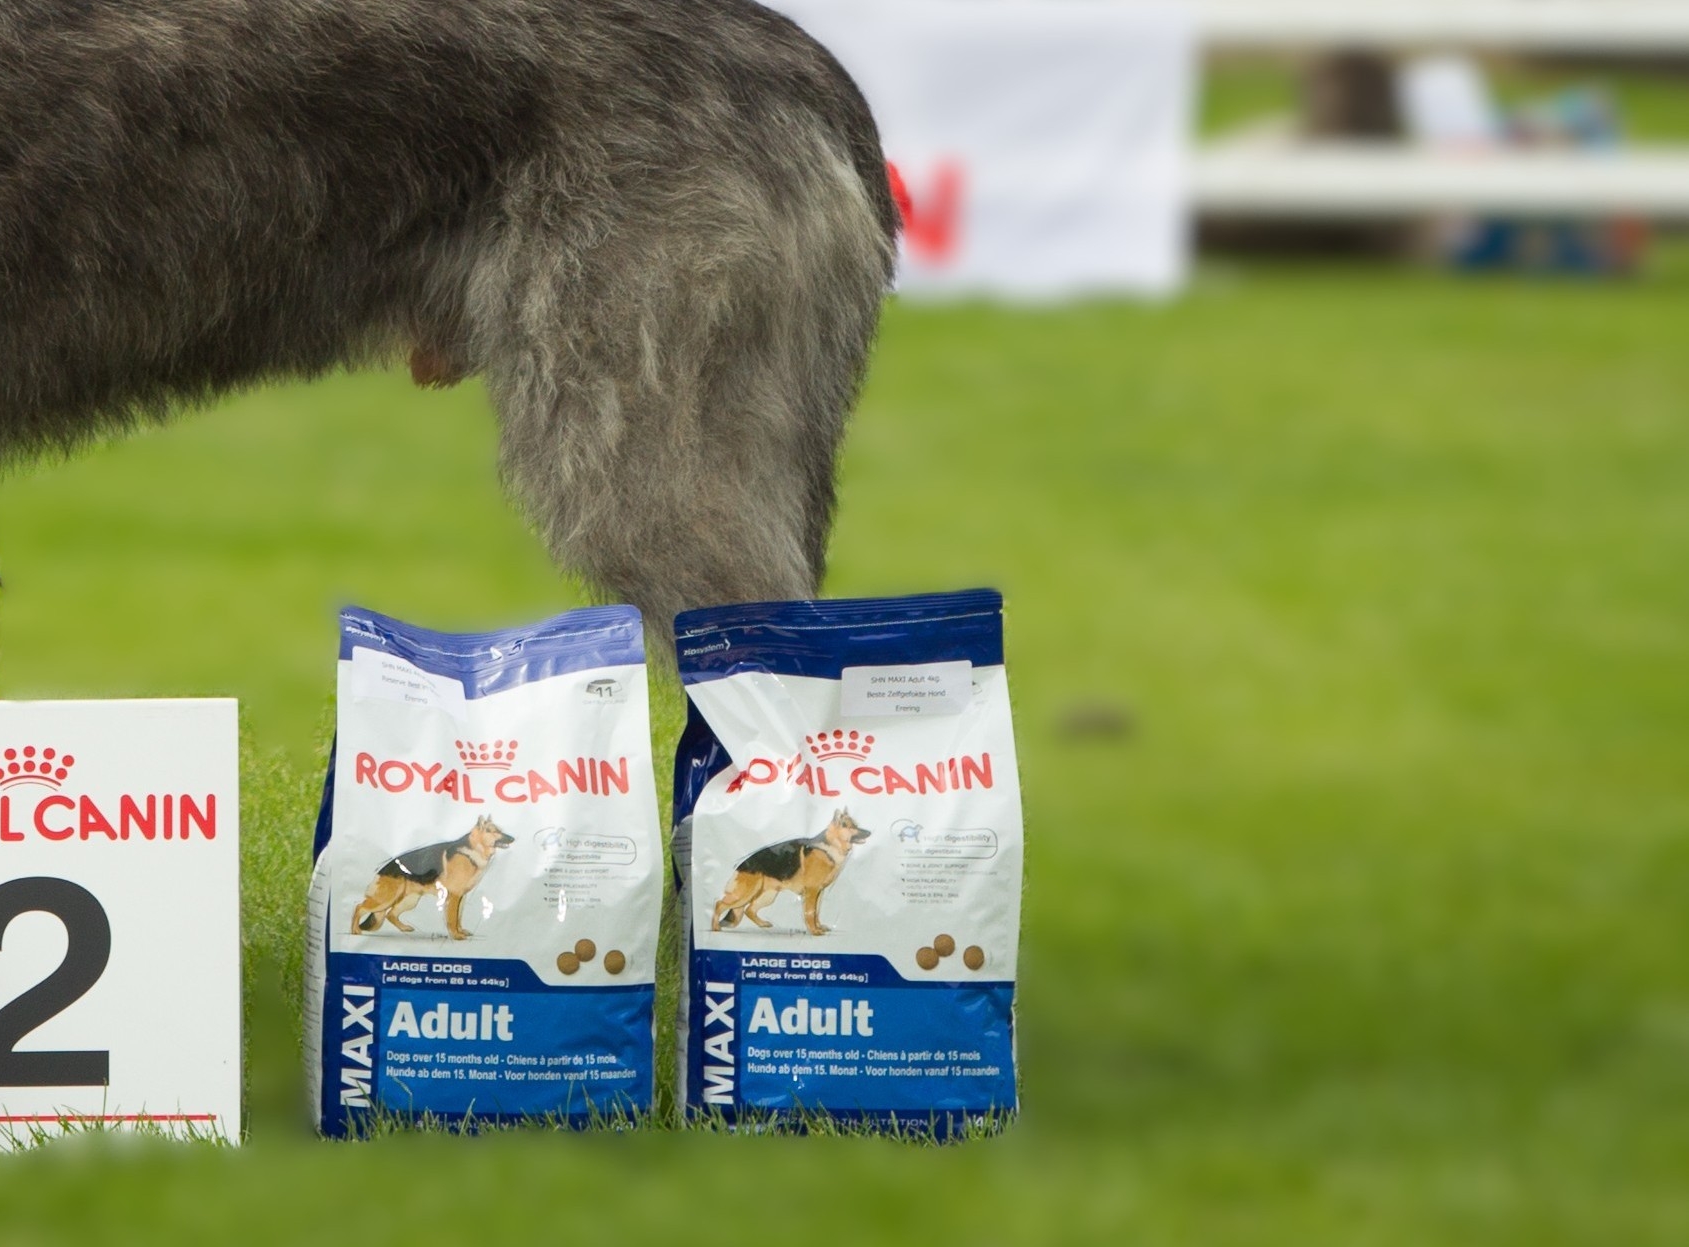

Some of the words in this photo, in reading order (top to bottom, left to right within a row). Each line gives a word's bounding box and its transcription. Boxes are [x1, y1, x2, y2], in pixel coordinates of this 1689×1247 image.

[888, 675, 907, 683] MAXI
[595, 686, 613, 698] 11
[355, 751, 486, 804] ROYAL
[494, 756, 630, 804] CANIN
[850, 752, 994, 796] CANIN
[33, 793, 217, 841] CANIN
[382, 961, 428, 972] LARGE
[432, 963, 472, 974] DOGS
[741, 957, 787, 968] LARGE
[791, 959, 831, 969] DOGS
[399, 975, 422, 985] dogs
[424, 976, 448, 985] from
[467, 977, 478, 986] to
[758, 971, 782, 981] dogs
[784, 971, 807, 980] from
[825, 973, 837, 981] to
[387, 1001, 514, 1042] Adult
[747, 997, 874, 1038] Adult
[339, 983, 376, 1108] MAXI
[703, 981, 735, 1105] MAXI
[386, 1050, 411, 1064] Dogs
[412, 1053, 433, 1063] over
[435, 1052, 446, 1063] 15
[447, 1053, 483, 1064] months
[484, 1054, 499, 1065] old
[506, 1054, 538, 1065] Chiens
[547, 1055, 571, 1067] partir
[572, 1055, 584, 1065] de
[585, 1054, 595, 1065] 15
[596, 1053, 617, 1064] mois
[747, 1046, 771, 1060] Dogs
[772, 1050, 794, 1059] over
[795, 1048, 807, 1059] 15
[808, 1049, 843, 1060] months
[844, 1050, 860, 1060] old
[866, 1049, 899, 1061] Chiens
[908, 1050, 933, 1063] partir
[933, 1051, 945, 1061] de
[948, 1050, 958, 1061] 15
[959, 1051, 981, 1061] mois
[386, 1065, 416, 1078] Hunde
[417, 1067, 430, 1078] ab
[431, 1068, 451, 1079] dem
[453, 1069, 467, 1080] 15.
[468, 1069, 497, 1080] Monat
[504, 1070, 526, 1081] Voor
[527, 1071, 561, 1080] honden
[563, 1069, 588, 1081] vanaf
[589, 1070, 600, 1080] 15
[600, 1068, 637, 1080] maanden
[747, 1062, 777, 1074] Hunde
[777, 1063, 791, 1075] ab
[791, 1064, 813, 1075] dem
[814, 1065, 827, 1075] 15.
[829, 1065, 858, 1076] Monat
[864, 1065, 888, 1076] Voor
[889, 1065, 923, 1077] honden
[924, 1065, 950, 1077] vanaf
[951, 1066, 961, 1076] 15
[962, 1065, 1000, 1076] maanden
